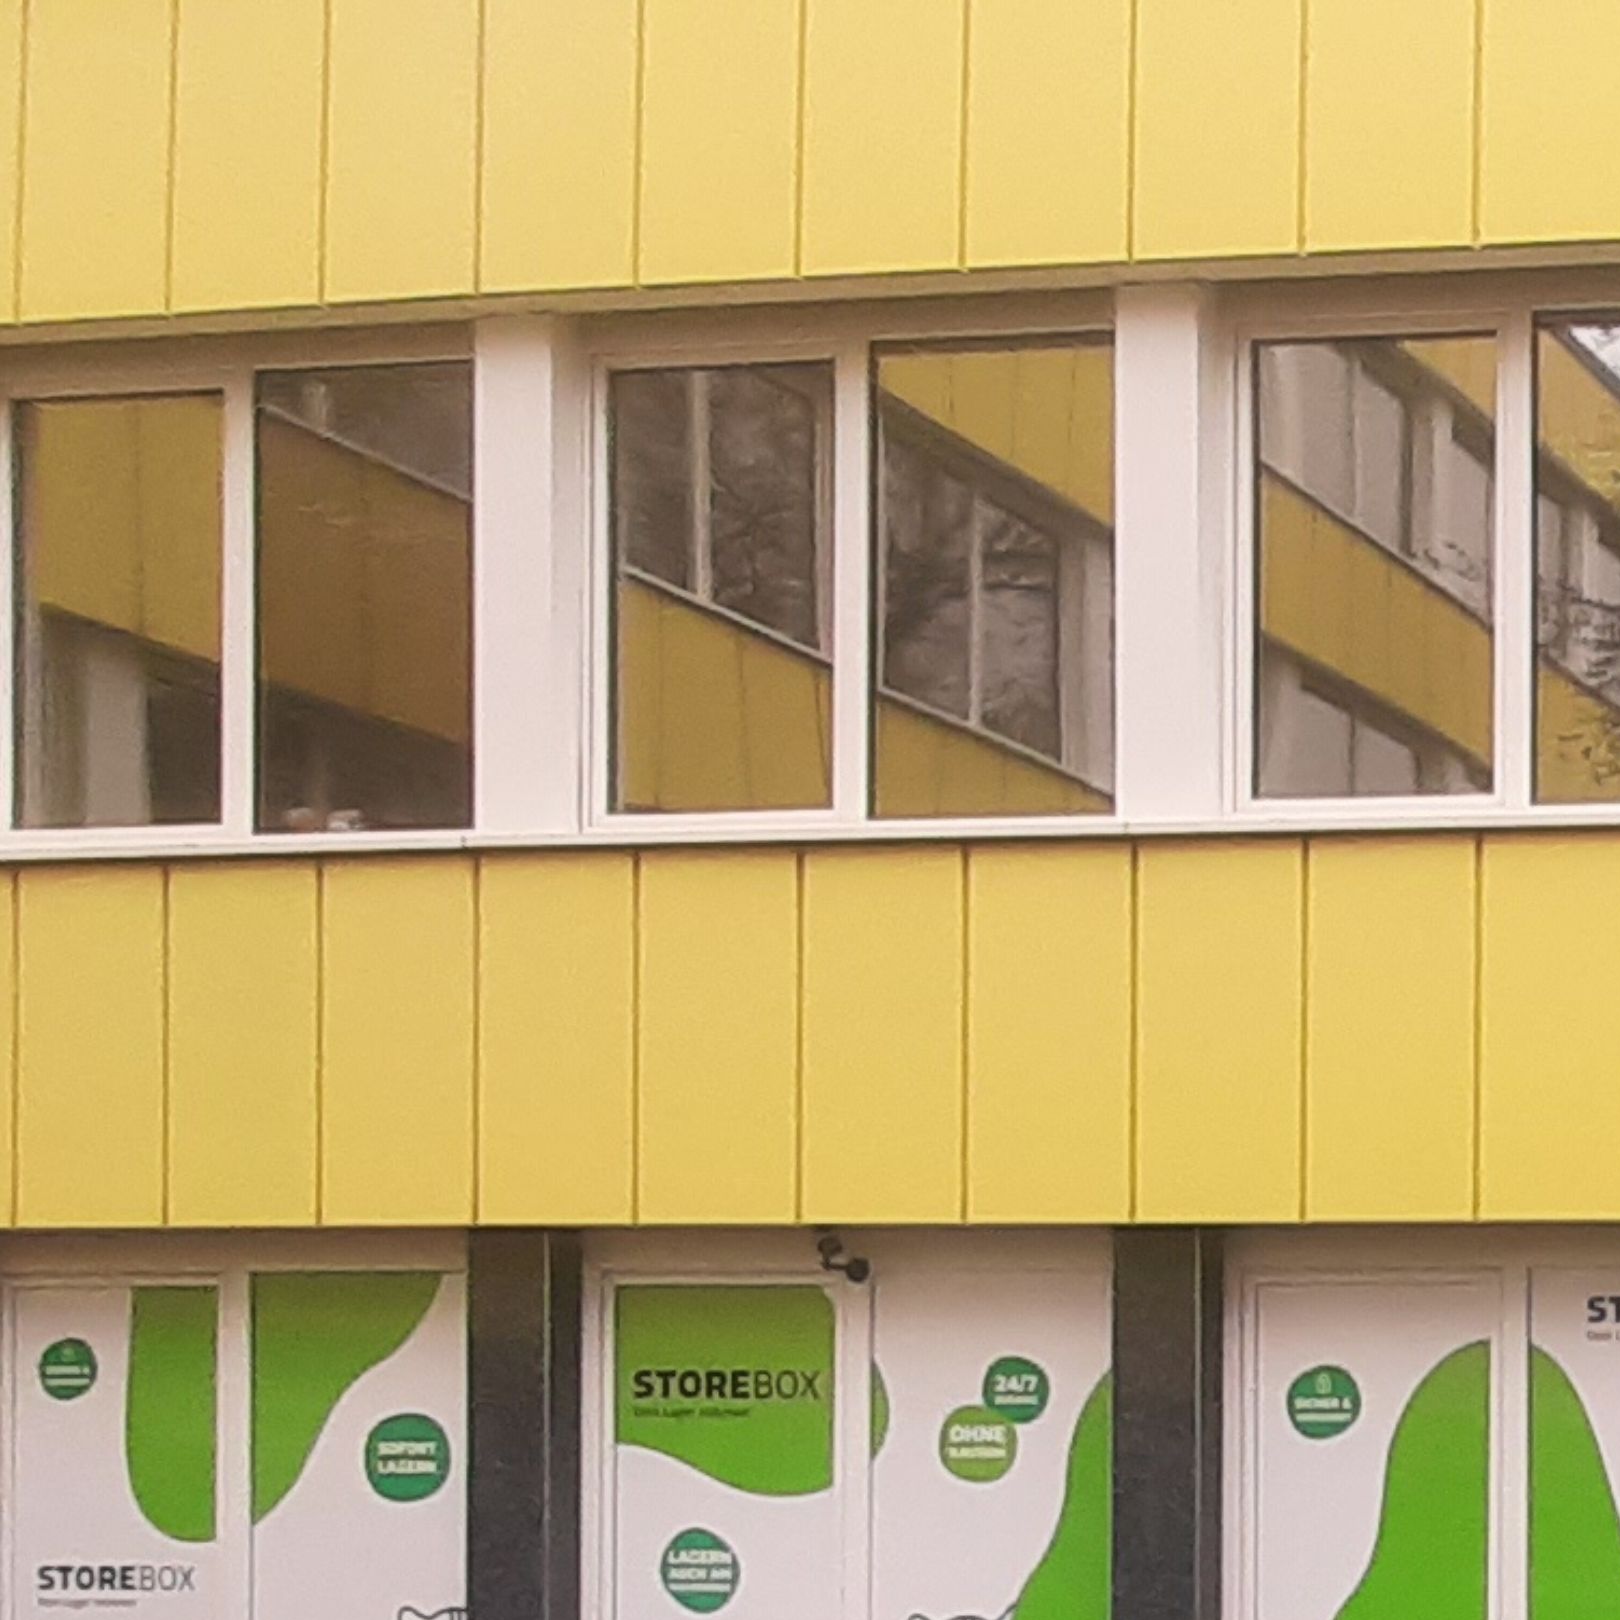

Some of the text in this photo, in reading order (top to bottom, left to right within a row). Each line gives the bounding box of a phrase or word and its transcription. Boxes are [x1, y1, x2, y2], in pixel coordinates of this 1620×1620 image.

[633, 1369, 821, 1399] STOREBOX
[994, 1373, 1039, 1392] 24/7
[949, 1424, 1007, 1442] OHNE
[38, 1565, 195, 1591] STOREBOX
